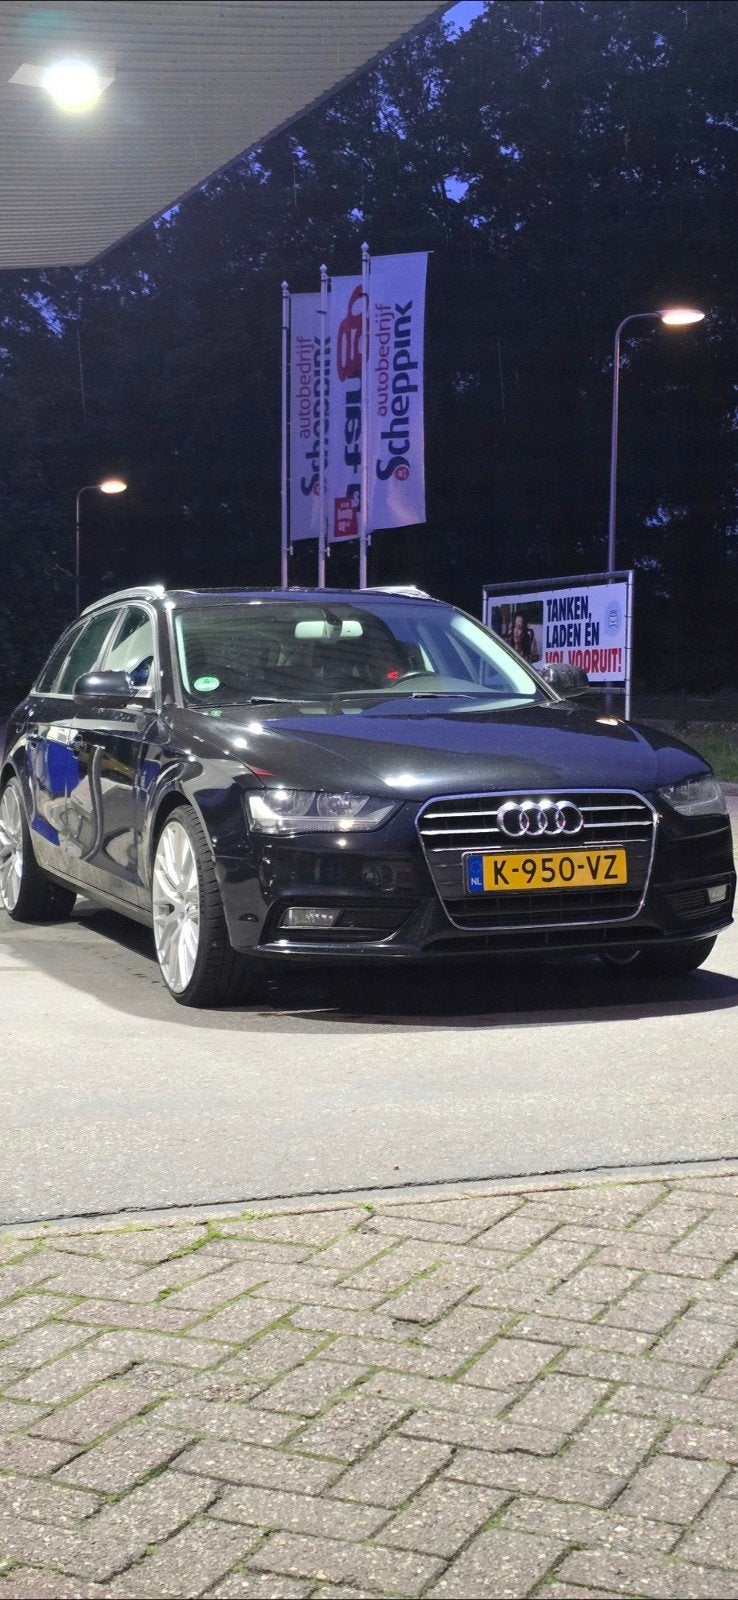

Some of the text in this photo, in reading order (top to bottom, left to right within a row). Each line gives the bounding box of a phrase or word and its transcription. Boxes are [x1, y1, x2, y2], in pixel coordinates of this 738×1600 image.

[375, 303, 394, 417] autobedrijf
[296, 337, 314, 439] autobedrijf
[376, 300, 418, 481] Scheppink
[547, 595, 592, 622] TANKEN,
[546, 623, 581, 648] LADEN
[568, 648, 622, 673] VOORUIT!
[470, 877, 482, 886] NL
[493, 855, 618, 885] K-950-VZ
